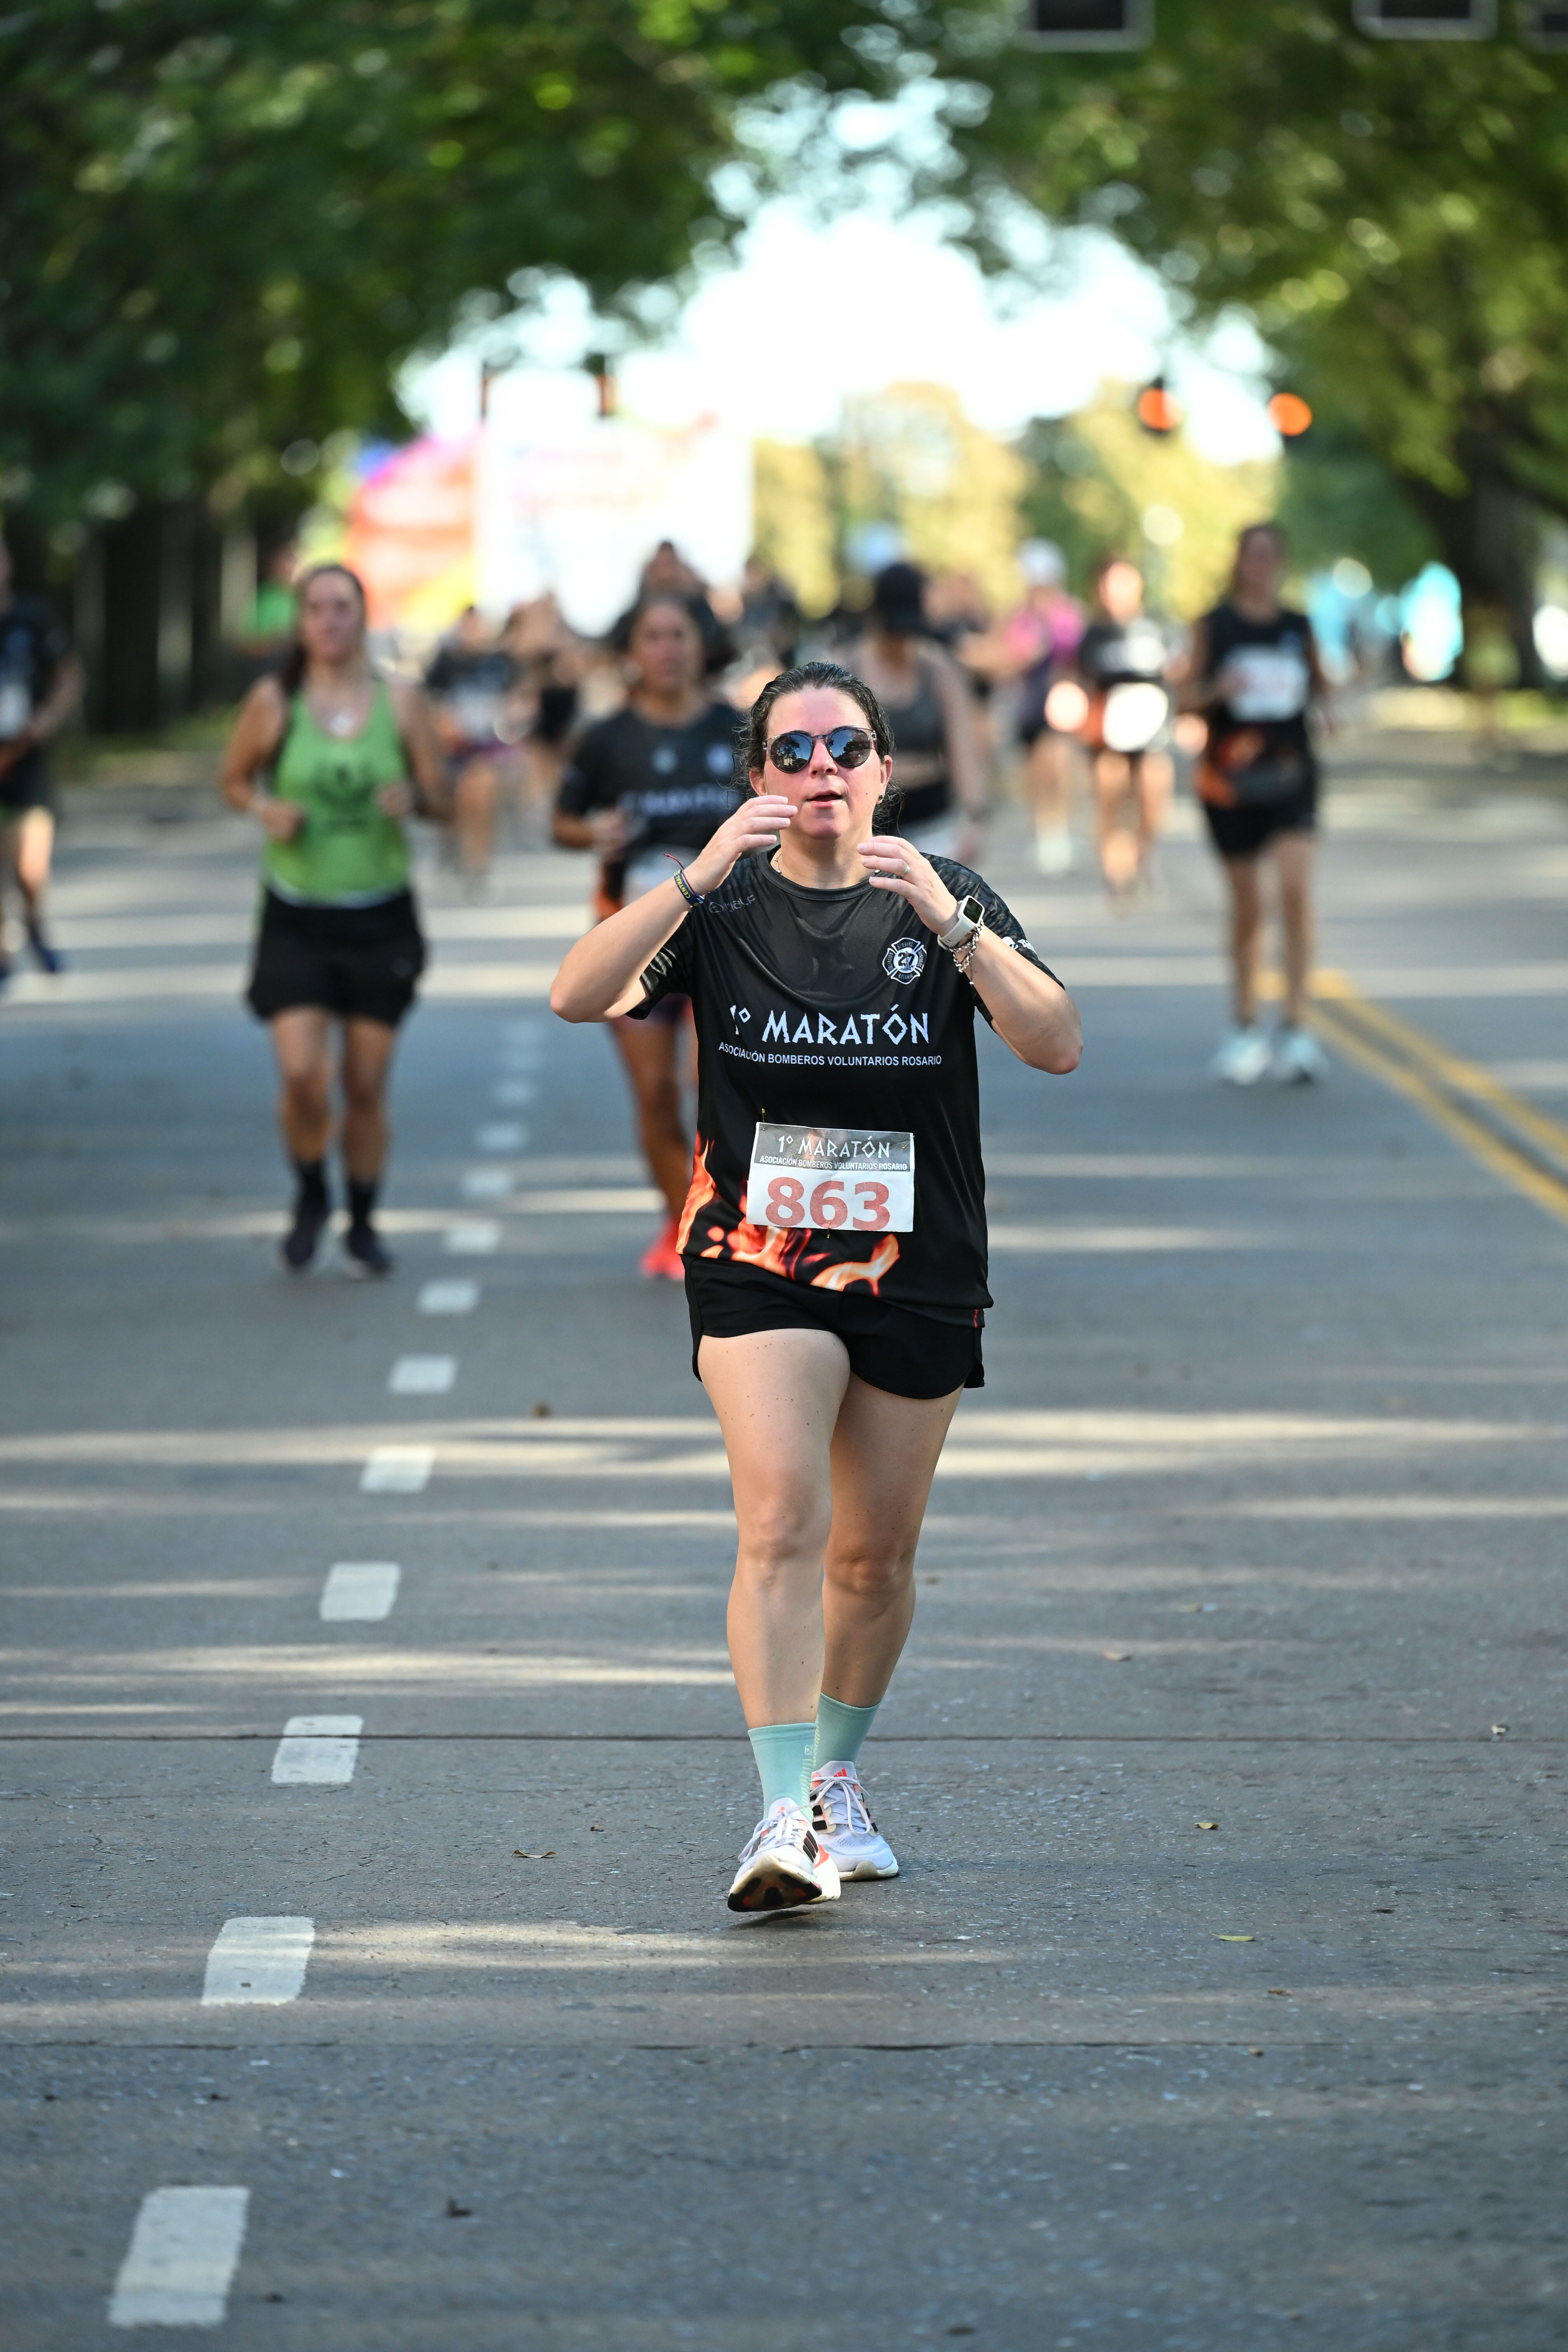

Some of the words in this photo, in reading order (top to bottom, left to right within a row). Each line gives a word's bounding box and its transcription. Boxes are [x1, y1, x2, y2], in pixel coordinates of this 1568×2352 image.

[898, 952, 915, 966] 27
[761, 1003, 929, 1045] MARATÓN
[719, 1042, 765, 1063] ASOCIACIÓN
[768, 1054, 825, 1065] BOMBEROS
[828, 1056, 899, 1066] VOLUNTARIOS
[902, 1055, 942, 1066] ROSARIO
[798, 1136, 890, 1158] MARATÓN
[760, 1155, 797, 1166] ASOCIACIÓN
[798, 1159, 833, 1169] BOMBEROS
[765, 1177, 890, 1231] 863
